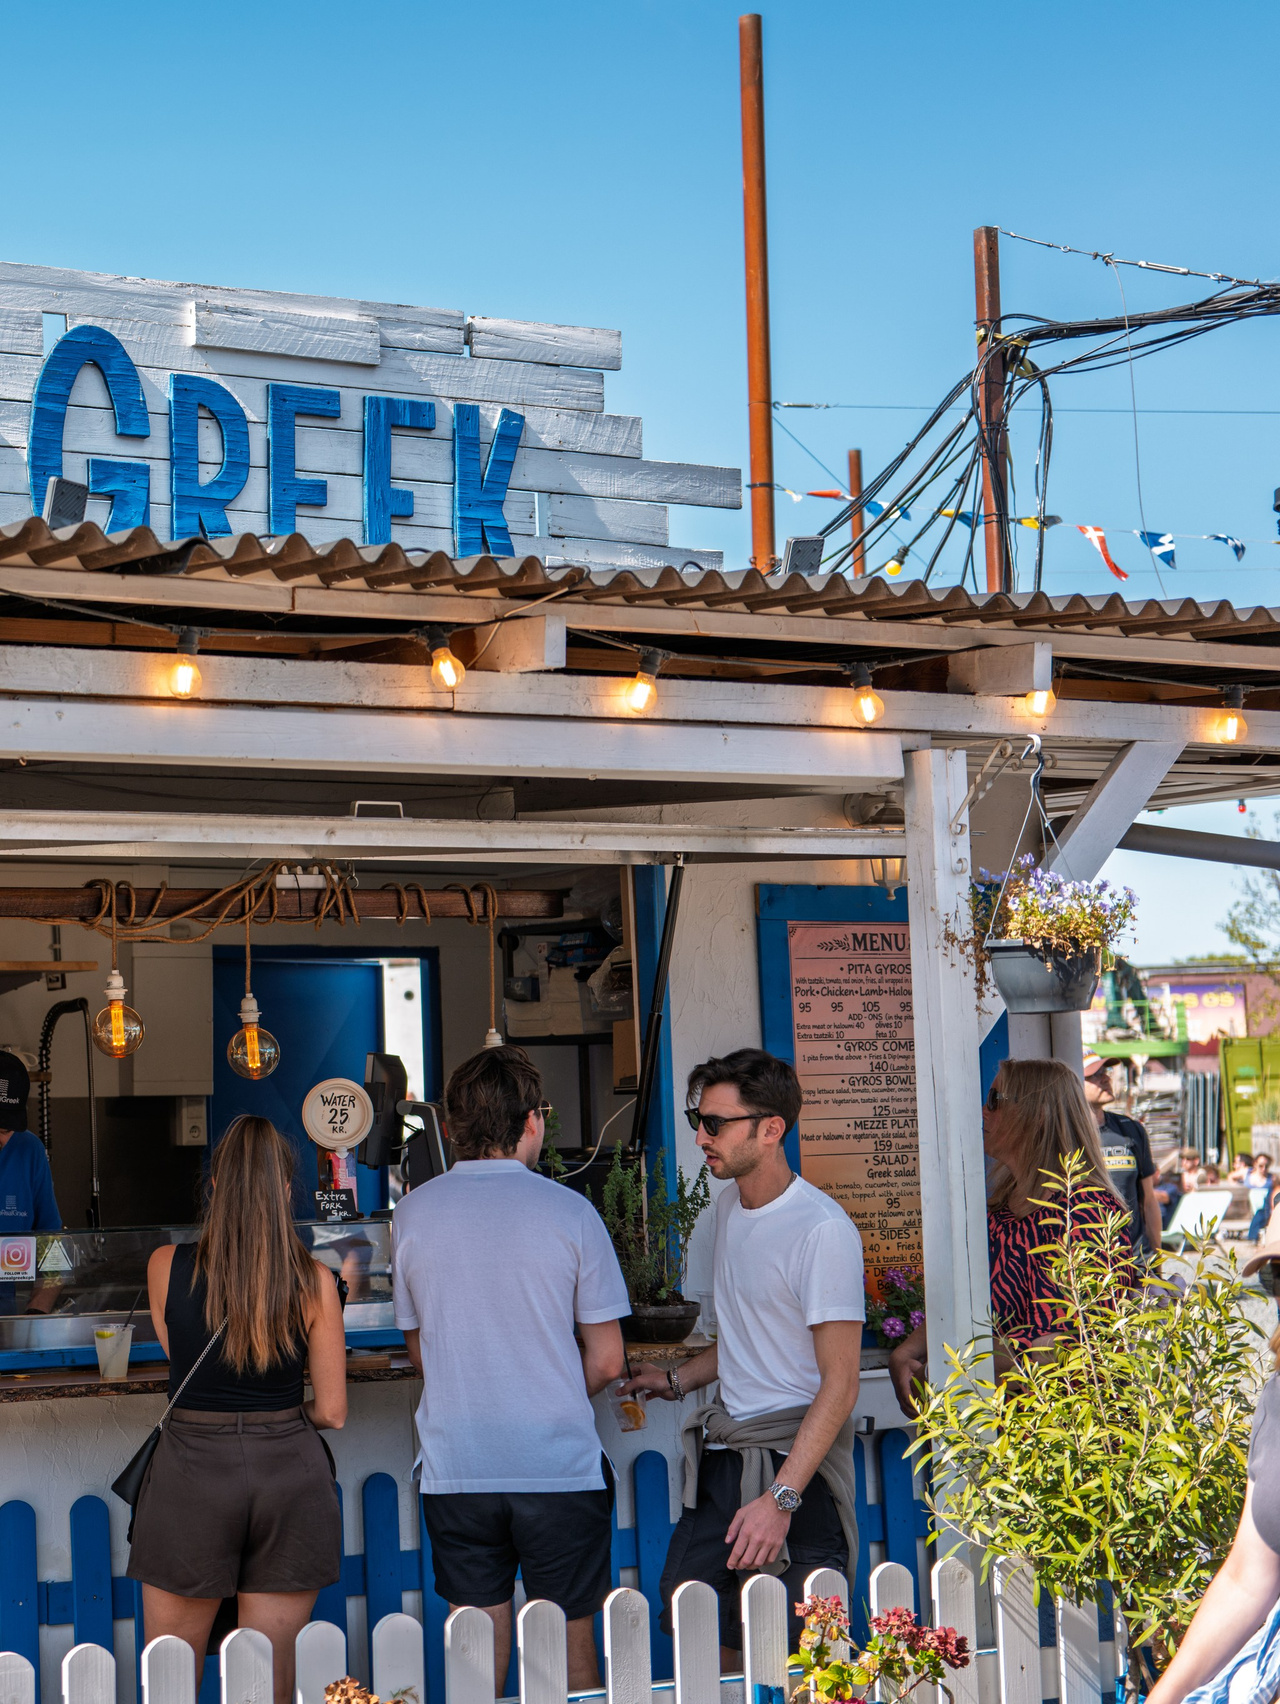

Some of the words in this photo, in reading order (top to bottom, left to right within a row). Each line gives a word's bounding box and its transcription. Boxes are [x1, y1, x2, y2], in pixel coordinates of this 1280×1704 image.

[27, 325, 525, 558] GREEK
[852, 932, 906, 952] MENU
[848, 964, 872, 974] PITA
[875, 964, 911, 974] GYROS
[794, 986, 816, 997] Pork
[821, 986, 855, 996] Chicken
[860, 986, 883, 996] Lamb
[889, 986, 912, 996] Halou
[798, 1002, 811, 1012] 95
[831, 1002, 843, 1012] 95
[862, 1002, 880, 1012] 105
[900, 1002, 912, 1012] 95
[888, 1030, 897, 1038] 10
[844, 1042, 878, 1051] GYROS
[883, 1041, 914, 1051] COMB
[808, 1055, 818, 1063] pita
[870, 1061, 888, 1072] 140
[890, 1063, 909, 1072] (Lamb
[848, 1076, 882, 1086] GYROS
[886, 1075, 916, 1085] BOWL
[321, 1093, 356, 1108] WATER
[832, 1098, 860, 1106] Vegetarian,
[873, 1106, 890, 1116] 125
[328, 1108, 349, 1125] 25
[854, 1120, 888, 1130] MEZZE
[891, 1119, 918, 1129] PLAT
[332, 1126, 347, 1134] KR.
[852, 1132, 880, 1142] vegetarian,
[874, 1140, 892, 1151] 159
[873, 1155, 908, 1166] SALAD
[867, 1168, 891, 1178] Greek
[894, 1167, 916, 1176] salad
[836, 1182, 862, 1190] tomato,
[315, 1191, 347, 1201] Extra
[852, 1192, 876, 1202] topped
[320, 1202, 342, 1210] FORK
[886, 1198, 900, 1208] 95
[850, 1210, 867, 1219] Meat
[855, 1221, 875, 1229] atziki
[878, 1219, 888, 1228] 10
[880, 1229, 910, 1240] SIDES
[869, 1244, 880, 1253] 40
[897, 1242, 915, 1251] Fries
[883, 1255, 907, 1263] tzatziki
[910, 1253, 921, 1262] 60
